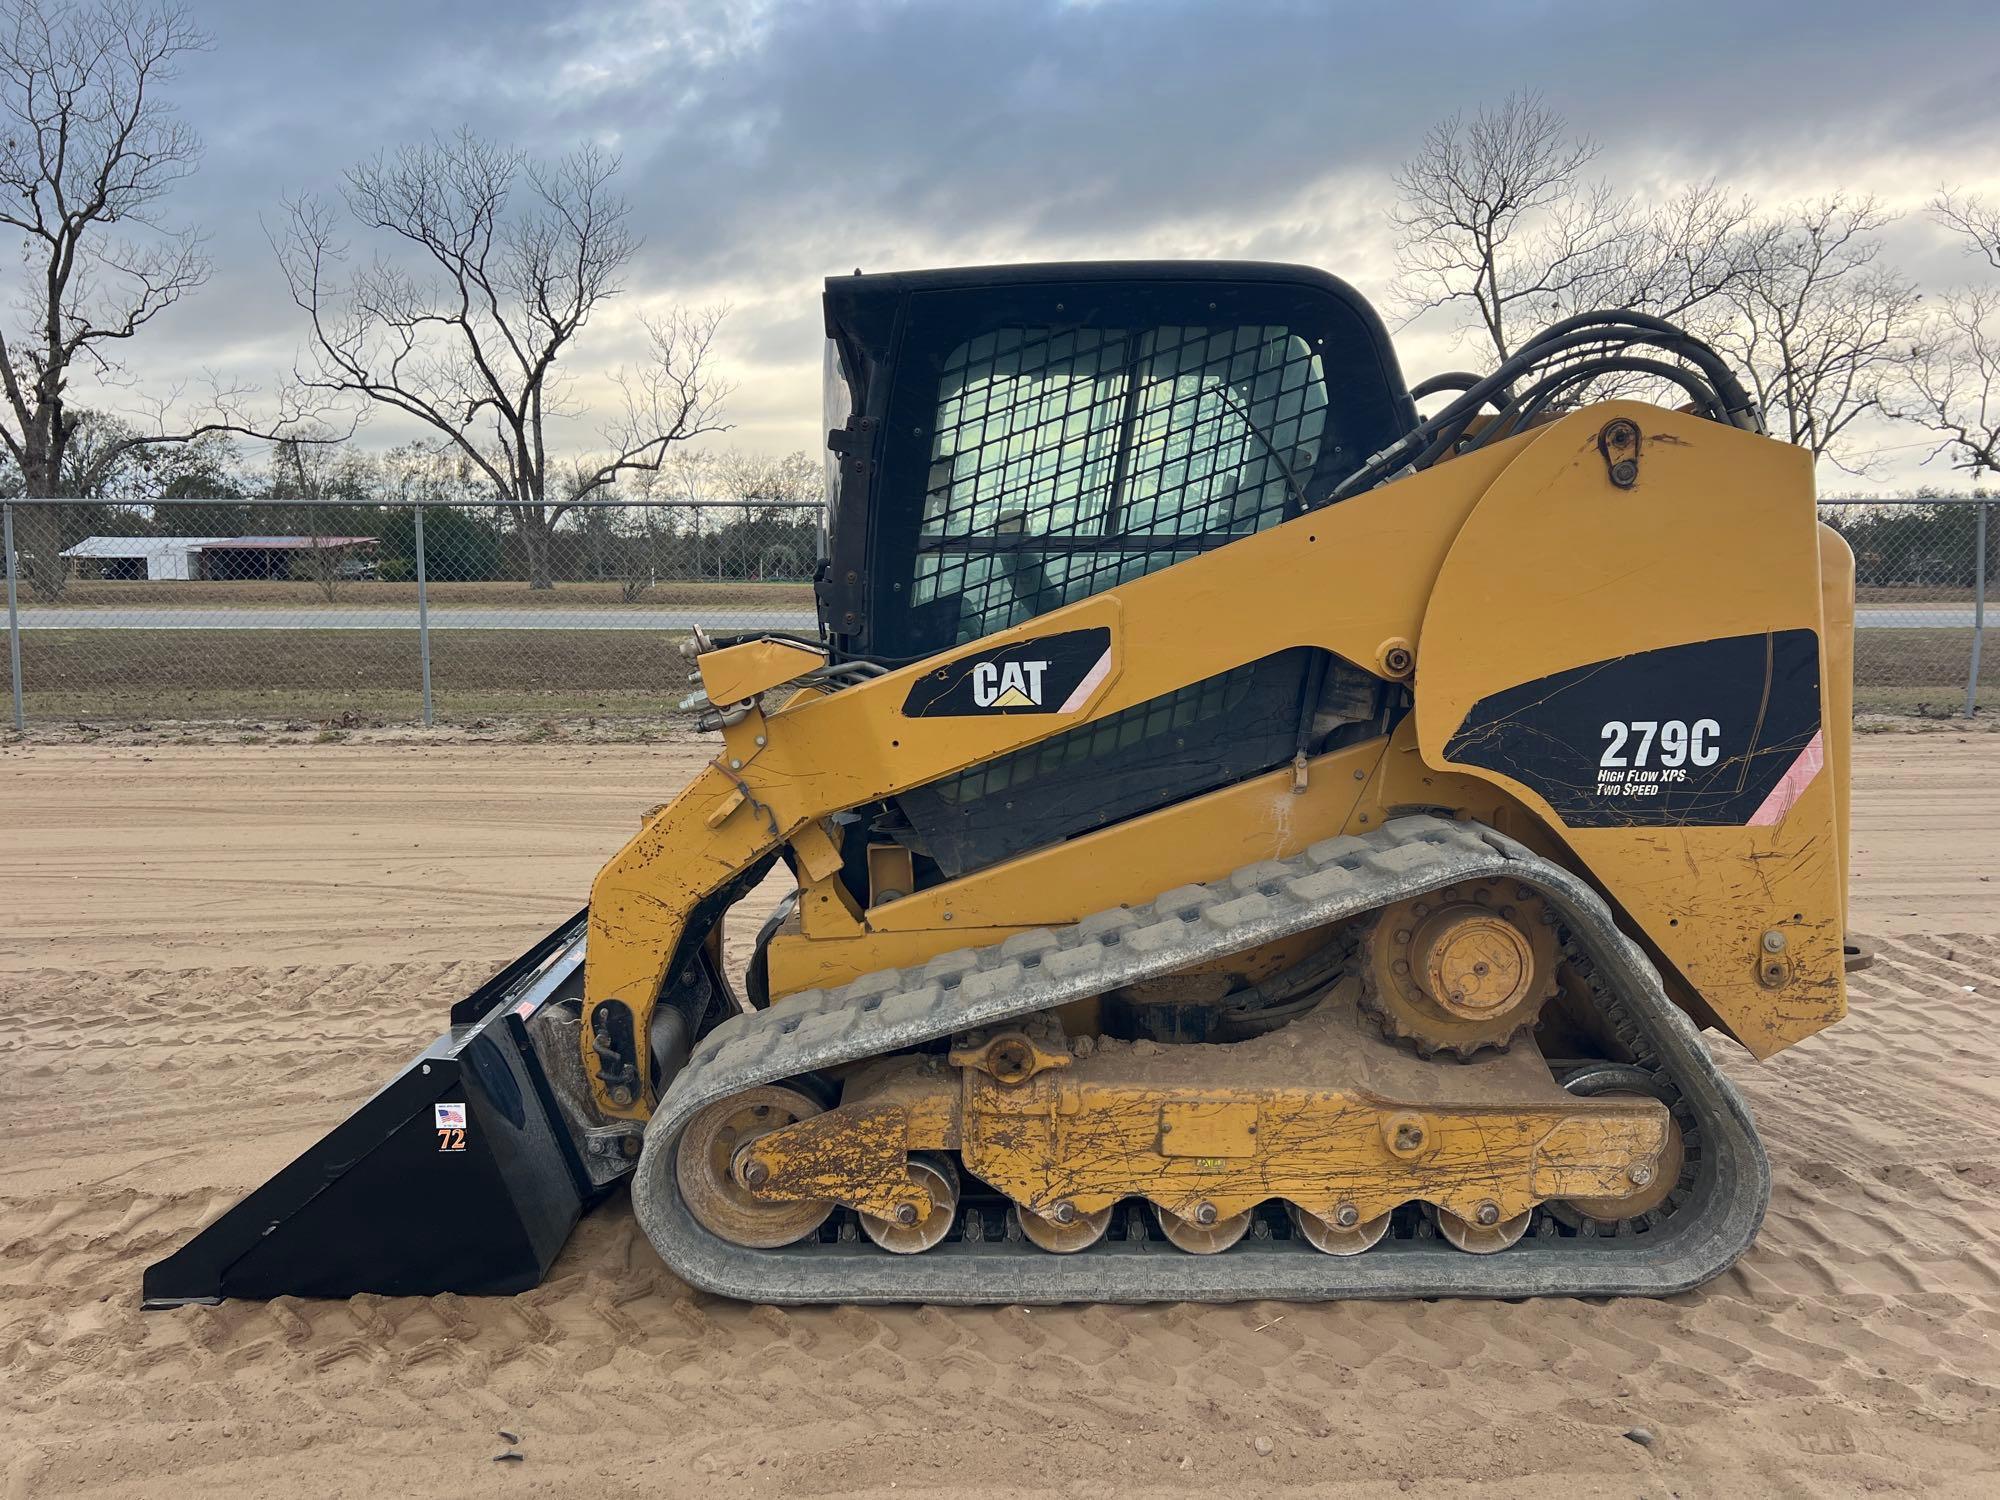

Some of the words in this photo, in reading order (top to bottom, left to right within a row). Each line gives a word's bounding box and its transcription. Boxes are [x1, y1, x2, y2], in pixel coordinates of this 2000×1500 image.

[973, 660, 1048, 708] CAT
[1600, 718, 1721, 767] 279C
[1660, 769, 1687, 782] XPS
[438, 1128, 466, 1149] 72
